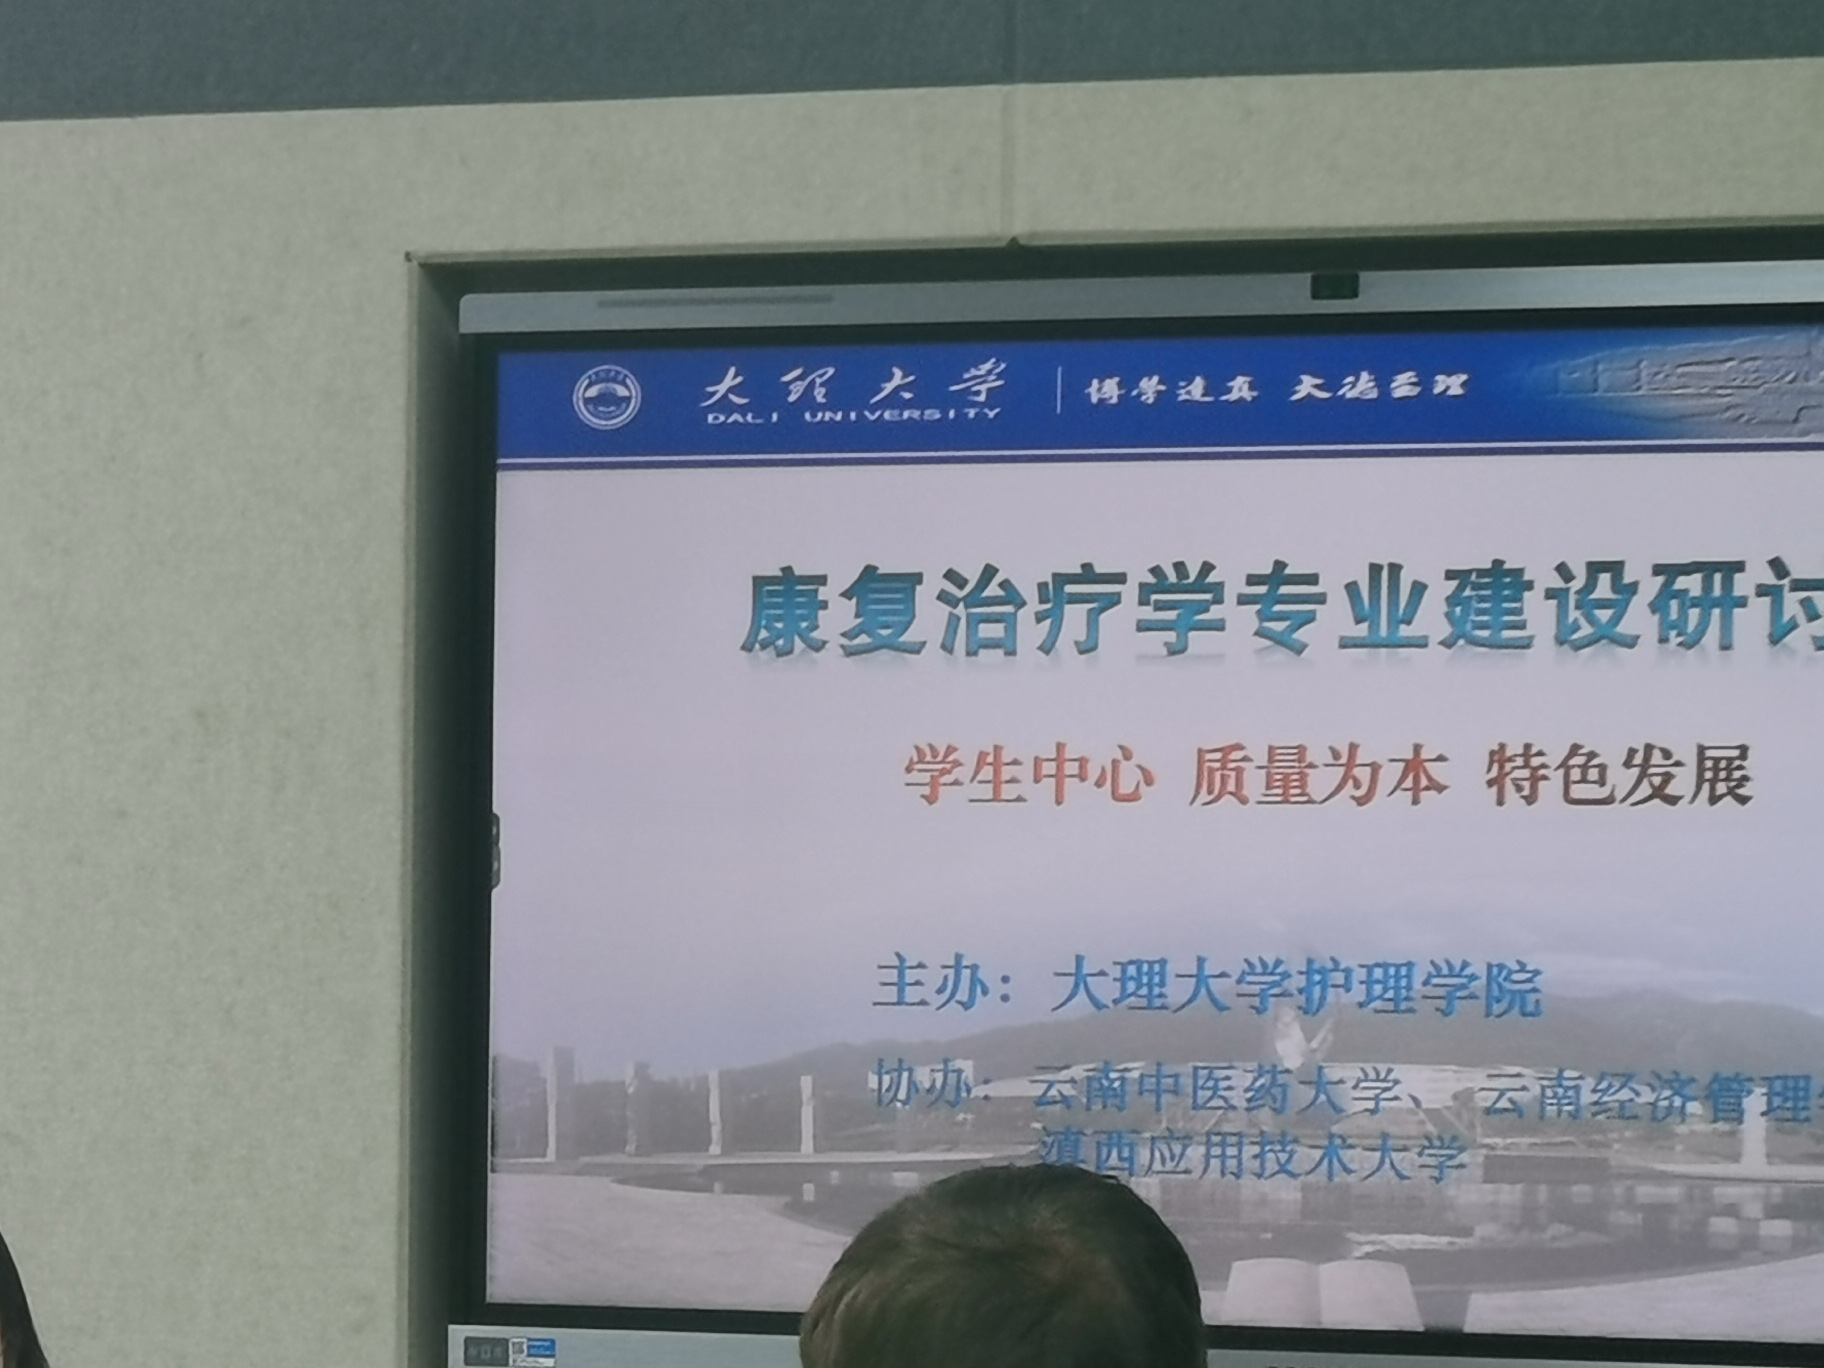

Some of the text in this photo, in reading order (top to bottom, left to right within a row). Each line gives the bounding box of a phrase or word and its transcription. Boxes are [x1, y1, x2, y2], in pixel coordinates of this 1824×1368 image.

[706, 406, 1002, 424] DALI UNIVERSITY
[740, 556, 1824, 657] 康复治疗学专业建设研讨
[904, 742, 1754, 807] 学生中心 质量为本 特色发展
[1477, 1070, 1824, 1126] 云南经济管理
[1040, 1125, 1468, 1185] 滇西应用技术大学
